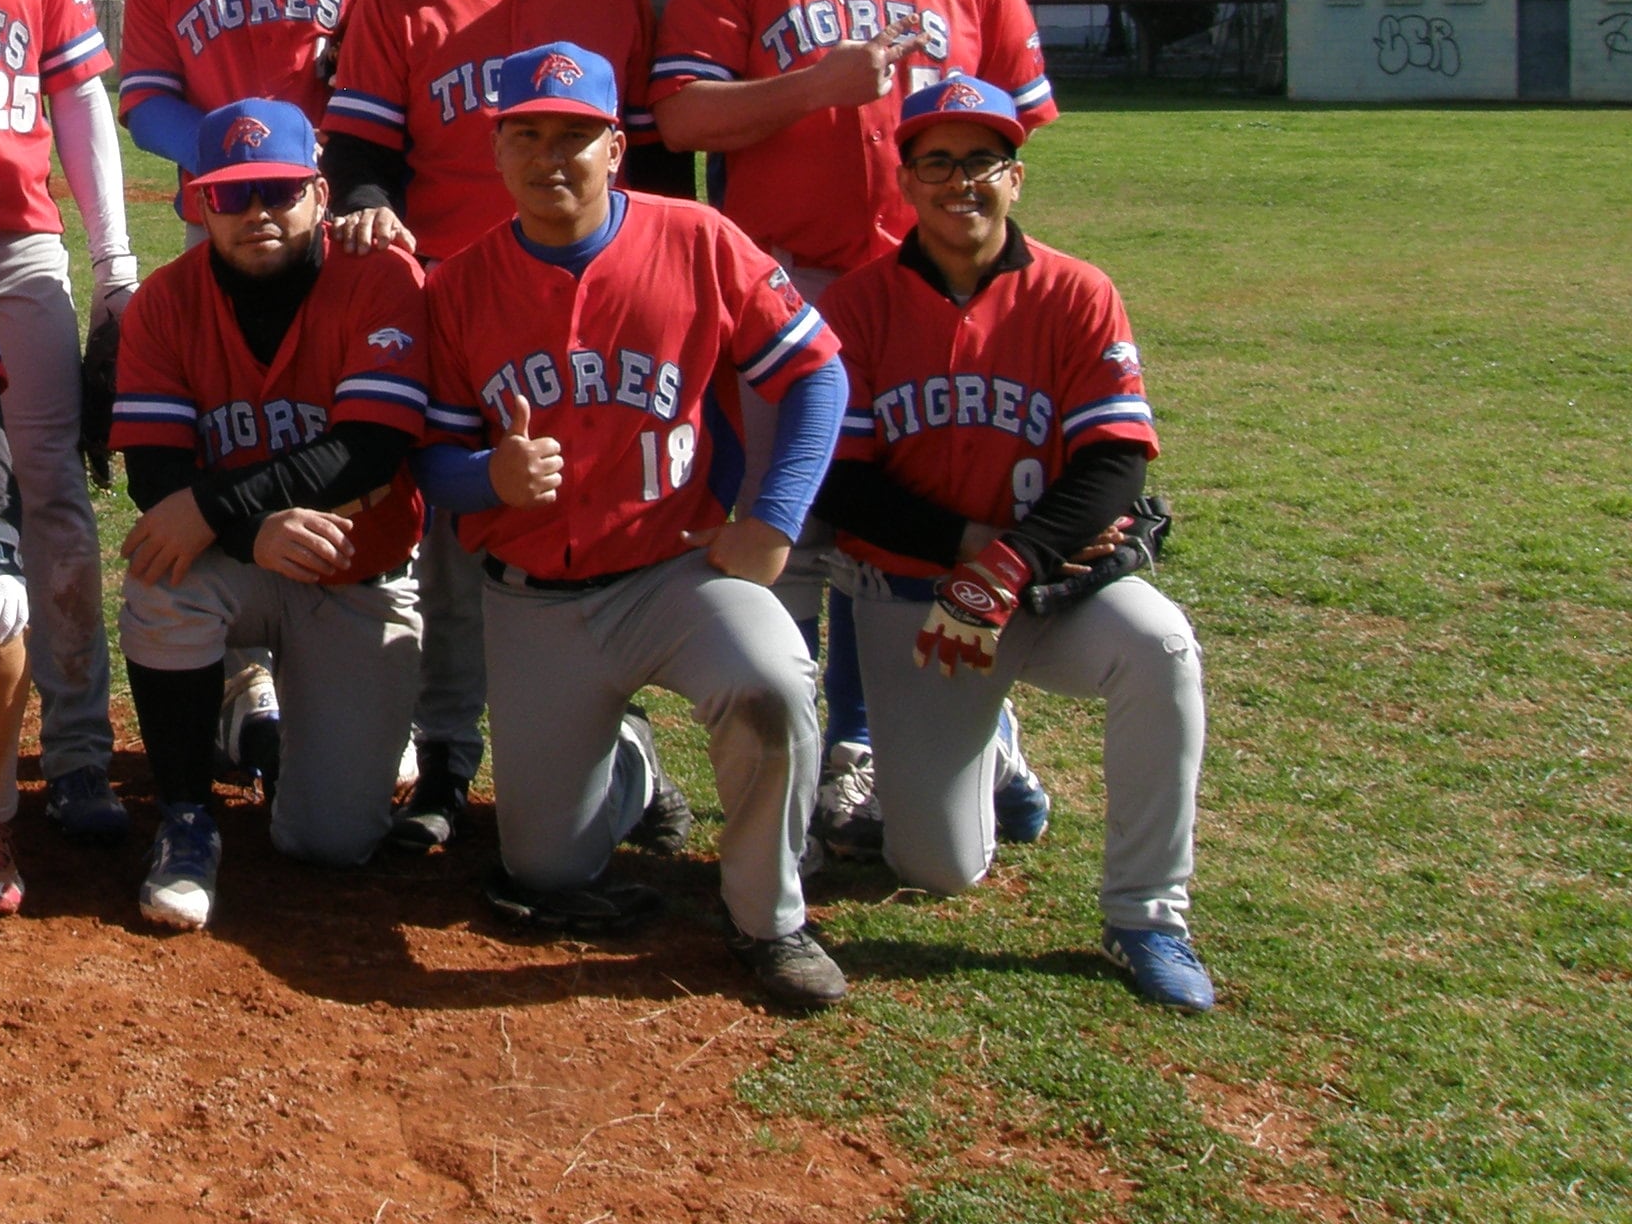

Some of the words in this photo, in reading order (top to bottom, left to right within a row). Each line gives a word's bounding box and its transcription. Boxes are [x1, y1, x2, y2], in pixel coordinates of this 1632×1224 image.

[872, 373, 1053, 448] TIGRES
[639, 422, 697, 502] 18
[1012, 457, 1044, 522] 9
